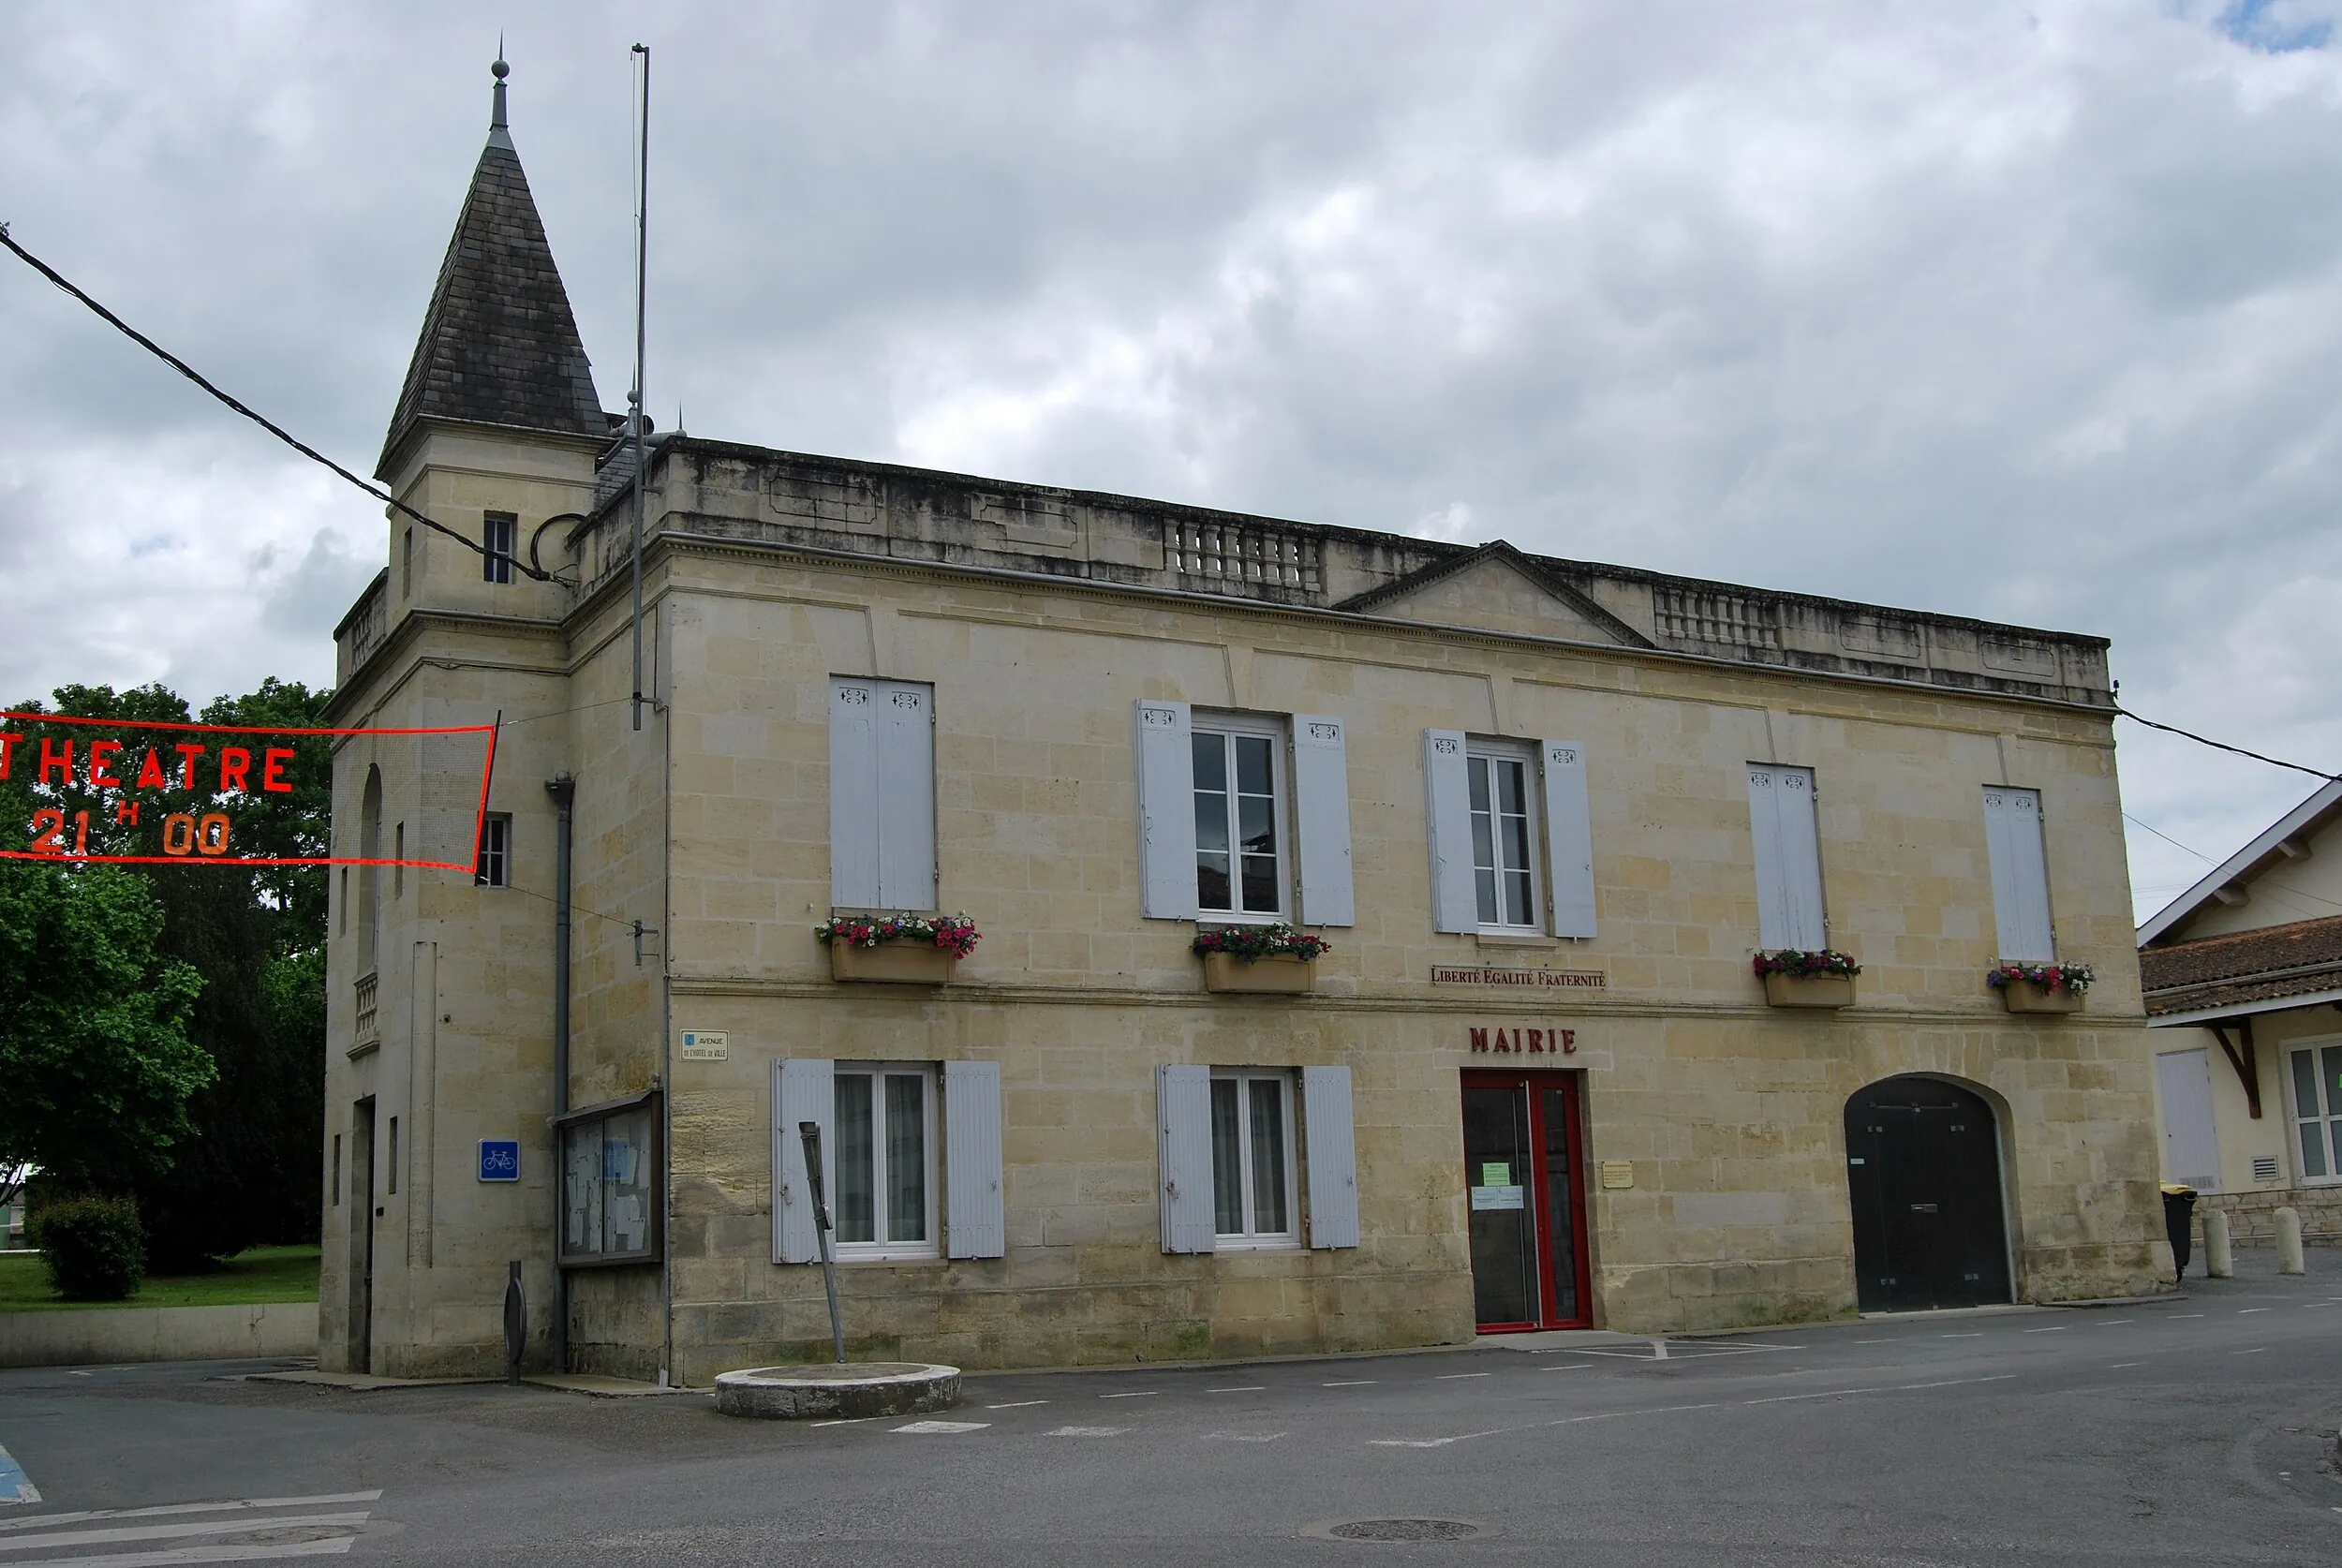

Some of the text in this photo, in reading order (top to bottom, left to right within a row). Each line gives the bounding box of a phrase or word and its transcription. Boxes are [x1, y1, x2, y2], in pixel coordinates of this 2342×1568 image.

[0, 733, 295, 792] THEATRE
[31, 800, 230, 855] 21 H 00
[1430, 968, 1481, 984] LIBERTÉ
[1538, 971, 1607, 987] FRATERNITÉ
[1470, 1028, 1577, 1054] MAIRIE
